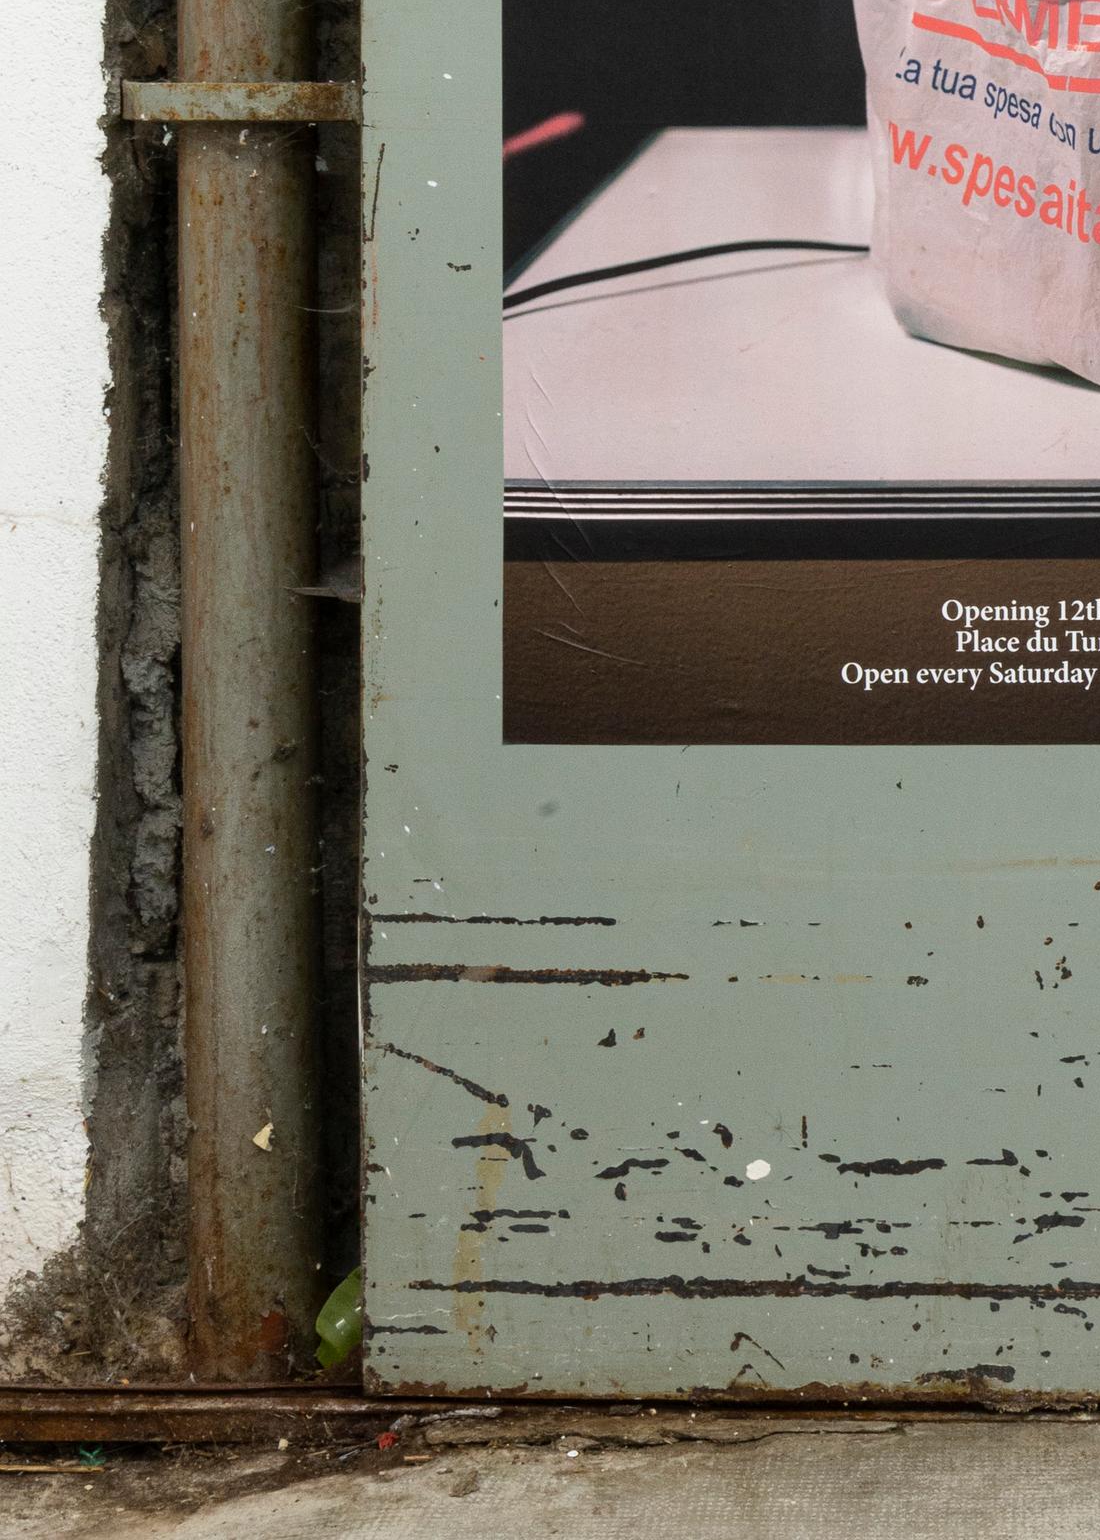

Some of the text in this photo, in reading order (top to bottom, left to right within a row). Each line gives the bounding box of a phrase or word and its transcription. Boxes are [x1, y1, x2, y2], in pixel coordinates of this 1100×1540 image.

[931, 59, 977, 101] tua
[984, 82, 1042, 129] spesa
[941, 598, 1050, 628] Opening
[955, 629, 1020, 653] Place
[1026, 629, 1058, 653] du
[841, 662, 909, 691] Open
[916, 667, 983, 691] every
[989, 660, 1098, 691] Saturday
